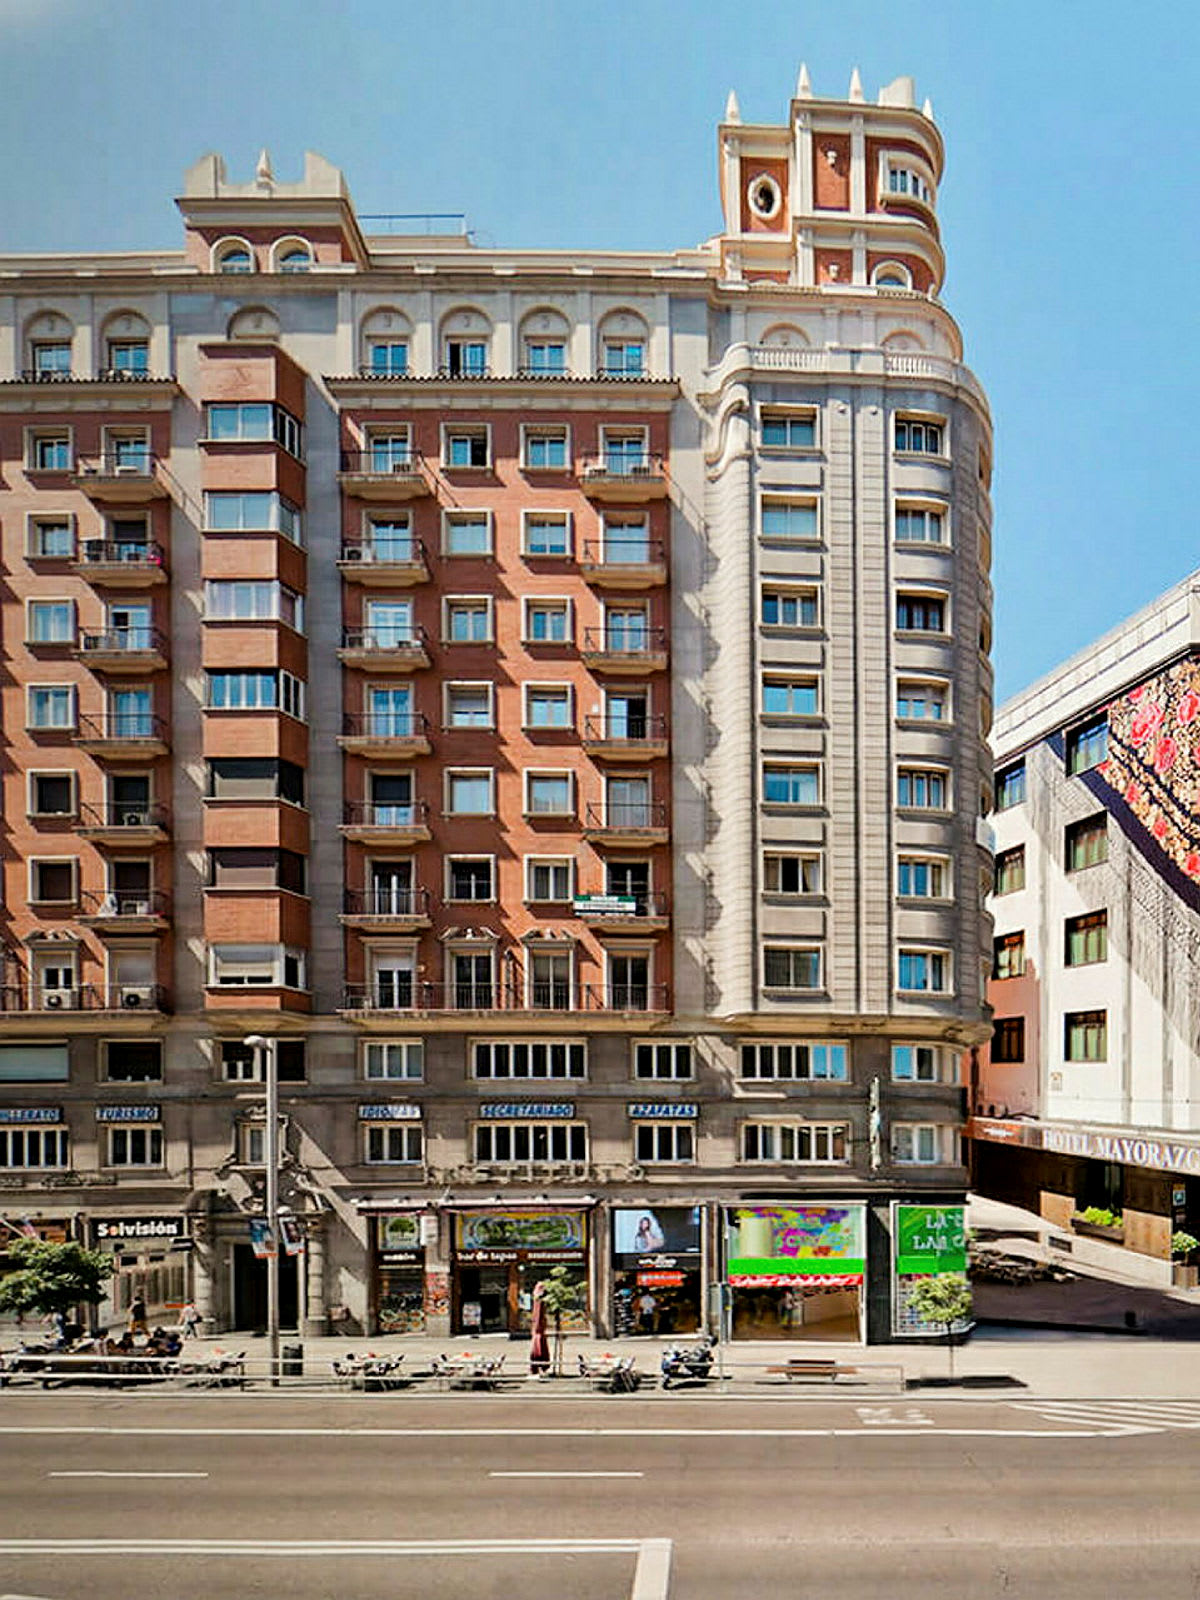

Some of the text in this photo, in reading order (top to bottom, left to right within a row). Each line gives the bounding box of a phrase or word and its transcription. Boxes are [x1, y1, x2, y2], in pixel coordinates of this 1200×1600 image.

[98, 1107, 156, 1120] TURISMO
[482, 1104, 572, 1118] SECRETARIADO
[631, 1104, 695, 1117] AZAFATAS
[1042, 1129, 1090, 1155] HOTEL
[97, 1221, 178, 1237] Solvisión
